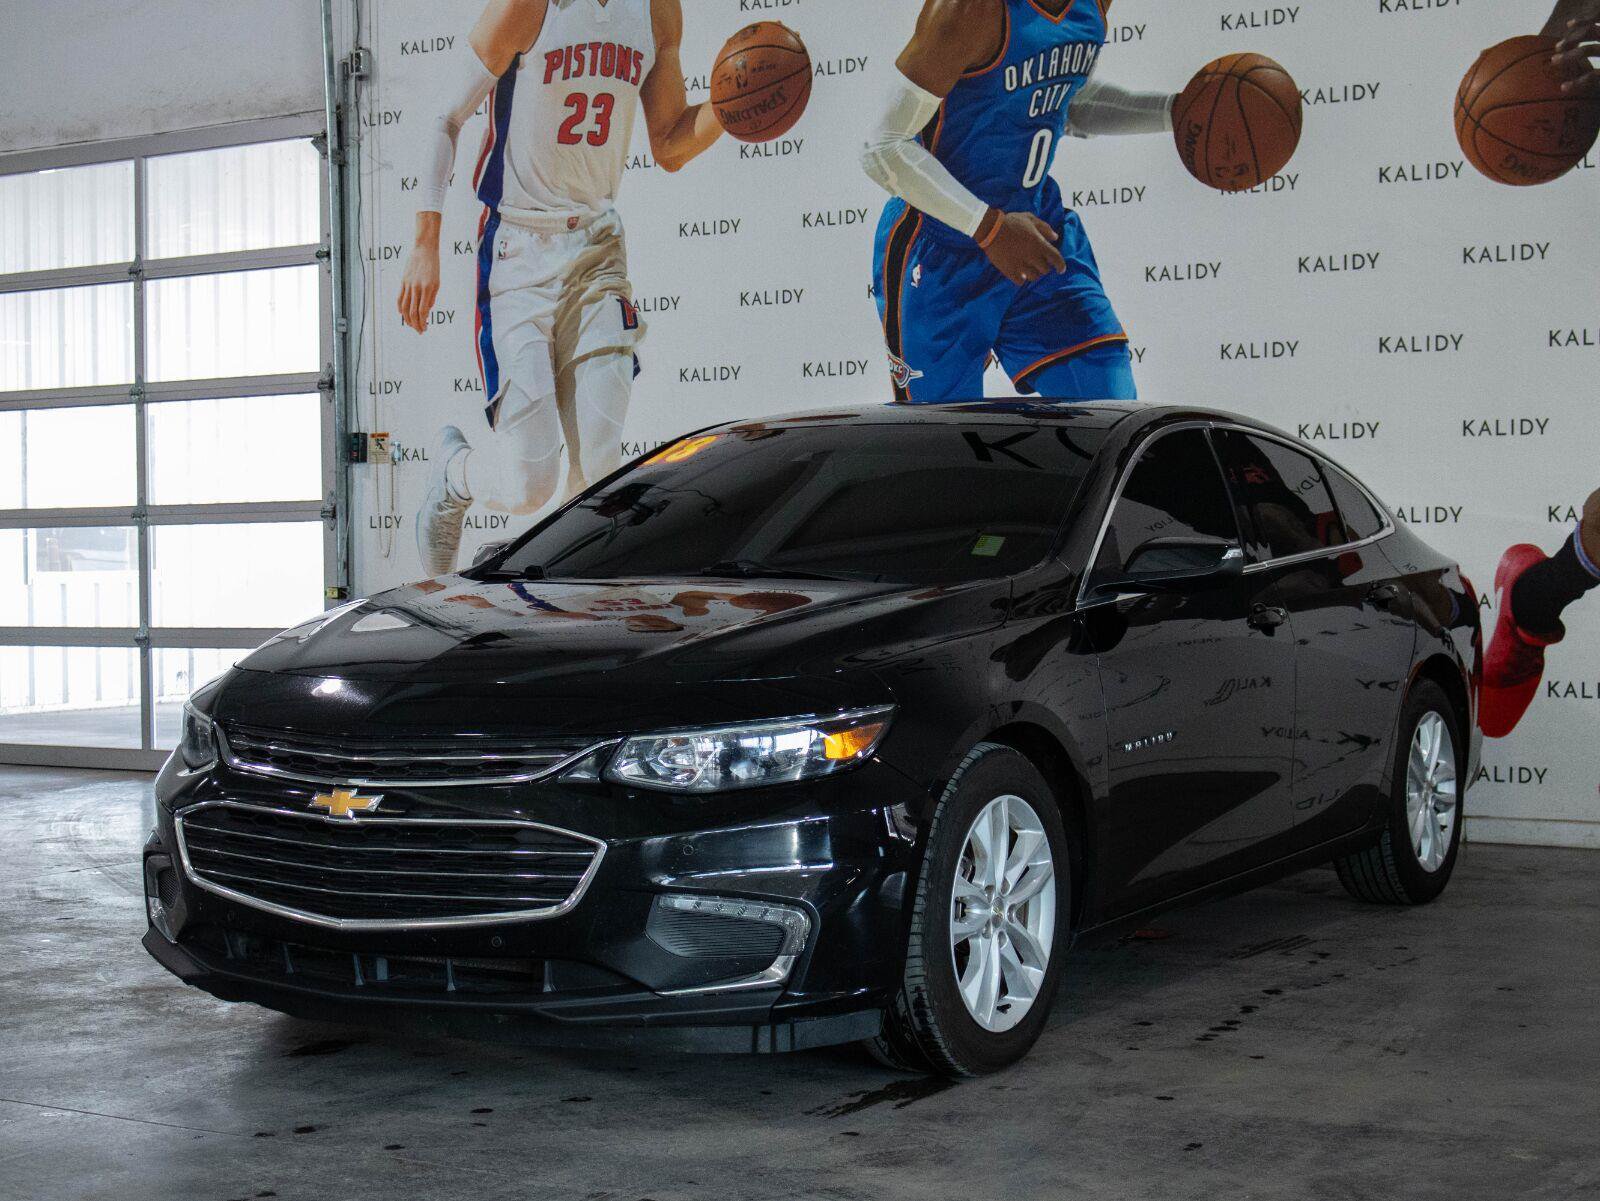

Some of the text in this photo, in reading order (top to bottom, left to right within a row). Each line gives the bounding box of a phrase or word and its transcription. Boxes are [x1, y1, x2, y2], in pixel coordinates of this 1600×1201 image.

[1221, 6, 1300, 31] KALIDY
[1104, 24, 1146, 44] IDY
[401, 36, 454, 55] KALIDY
[543, 42, 643, 86] PISTONS
[815, 56, 868, 77] ALIDY
[1028, 82, 1073, 119] CITY
[1300, 82, 1380, 105] KALIDY
[557, 92, 616, 147] 23
[740, 139, 803, 159] KALIDY
[1022, 128, 1053, 190] 0
[1378, 161, 1463, 183] KALIDY
[1073, 186, 1146, 207] KALIDY
[803, 208, 868, 228] KALIDY
[680, 219, 741, 237] KALIDY
[369, 245, 402, 261] LIDY
[1298, 252, 1380, 273] KALIDY
[1463, 242, 1550, 264] KALIDY
[1145, 262, 1222, 282] KALIDY
[634, 296, 680, 312] ALIDY
[740, 289, 803, 306] KALIDY
[1221, 341, 1299, 360] KALIDY
[1379, 334, 1463, 353] KALIDY
[680, 366, 741, 382] KALIDY
[803, 360, 868, 378] KALIDY
[369, 380, 402, 395] LIDY
[454, 378, 482, 392] KAL
[1298, 422, 1380, 440] KALIDY
[1463, 418, 1550, 437] KALIDY
[402, 448, 429, 461] KAL
[370, 515, 402, 529] LIDY
[464, 515, 509, 529] ALIDY
[1397, 507, 1463, 525] ALIDY
[1124, 732, 1173, 752] MALIBU
[1478, 766, 1548, 784] ALIDY
